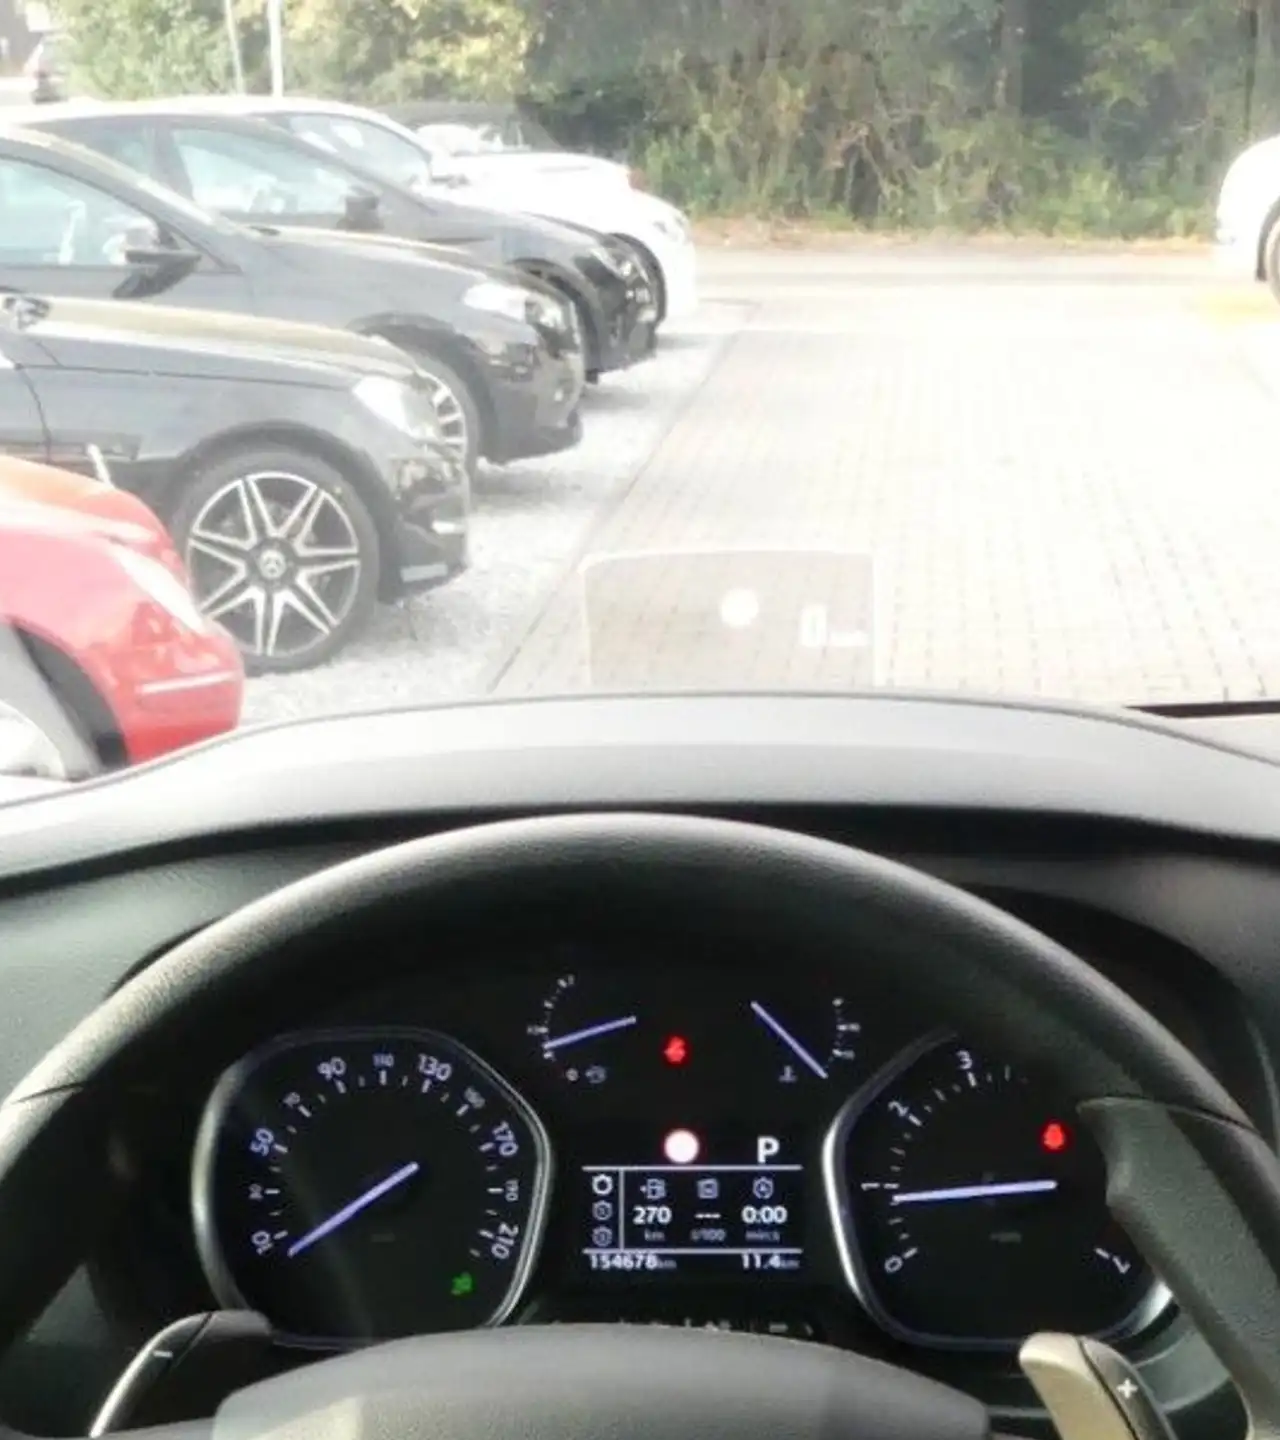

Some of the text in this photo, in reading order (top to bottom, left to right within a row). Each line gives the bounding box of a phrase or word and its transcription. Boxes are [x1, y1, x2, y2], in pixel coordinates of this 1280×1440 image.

[317, 1056, 346, 1080] 90
[419, 1054, 452, 1082] 130
[957, 1049, 973, 1069] 3
[888, 1100, 910, 1117] 2
[250, 1128, 275, 1156] 50
[493, 1121, 519, 1156] 170
[757, 1136, 780, 1164] P
[632, 1205, 673, 1225] 270
[740, 1205, 789, 1225] 0:00
[491, 1221, 520, 1260] 210
